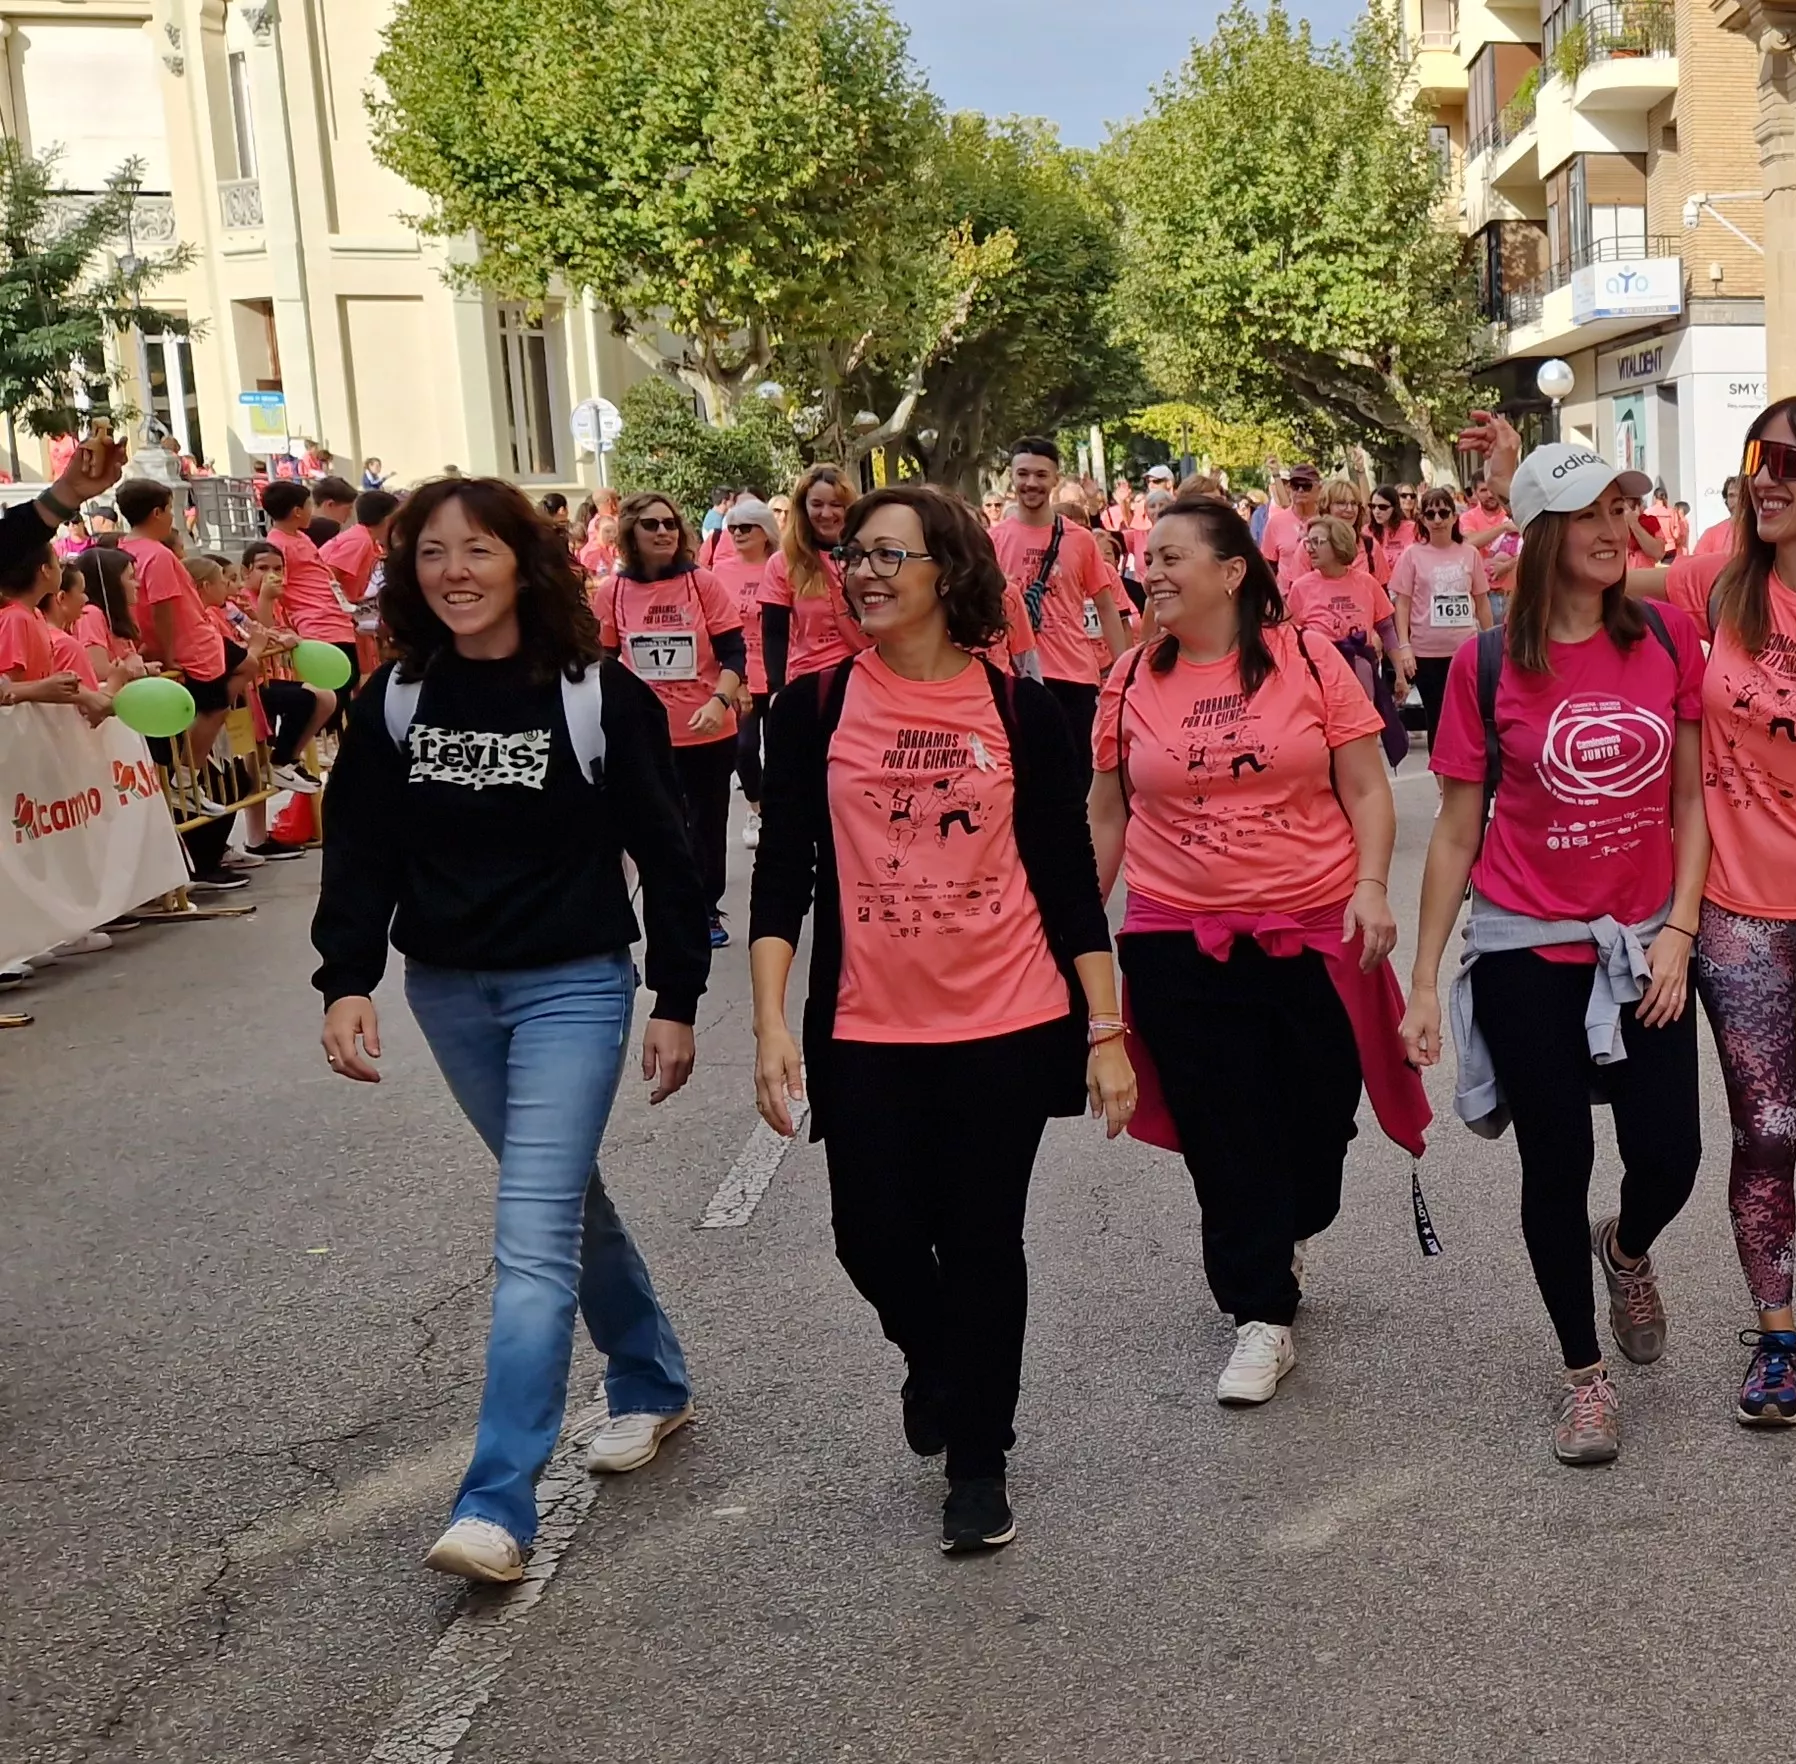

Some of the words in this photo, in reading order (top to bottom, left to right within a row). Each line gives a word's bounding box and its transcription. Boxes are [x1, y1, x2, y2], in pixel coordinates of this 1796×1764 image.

[1617, 346, 1663, 380] VITALDENT
[1552, 452, 1606, 479] adida
[1436, 604, 1469, 617] 1630
[649, 648, 677, 666] 17
[1193, 692, 1244, 715] CORRAMOS
[1181, 715, 1201, 728] POR
[1202, 714, 1213, 727] LA
[897, 729, 960, 750] CORRAMOS
[881, 750, 906, 769] POR
[907, 750, 920, 770] LA
[923, 749, 969, 770] CIENCIA
[1581, 744, 1620, 762] JUNTOS
